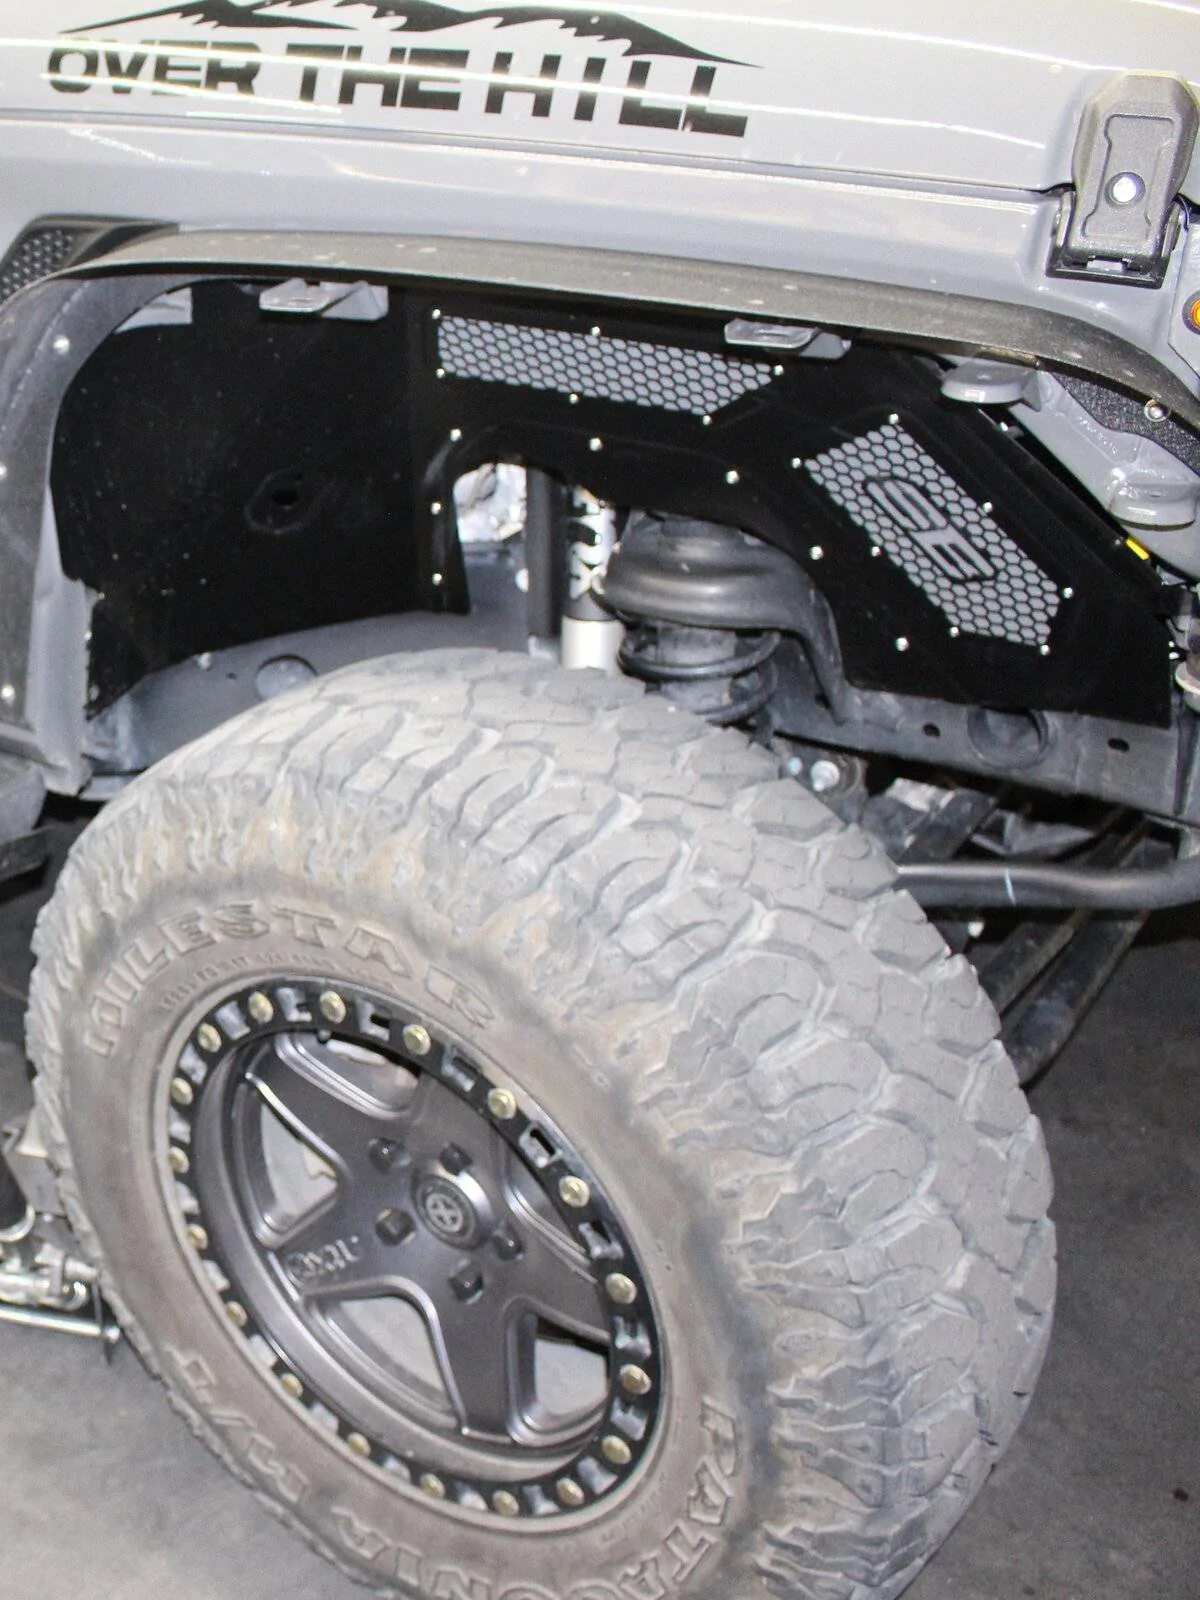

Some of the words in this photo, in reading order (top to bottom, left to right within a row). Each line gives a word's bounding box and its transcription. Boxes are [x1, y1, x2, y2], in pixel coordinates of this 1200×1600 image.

[47, 39, 262, 96] OVER
[283, 42, 471, 110] THE
[484, 51, 749, 138] HILL
[84, 902, 496, 1058] MILESTAR
